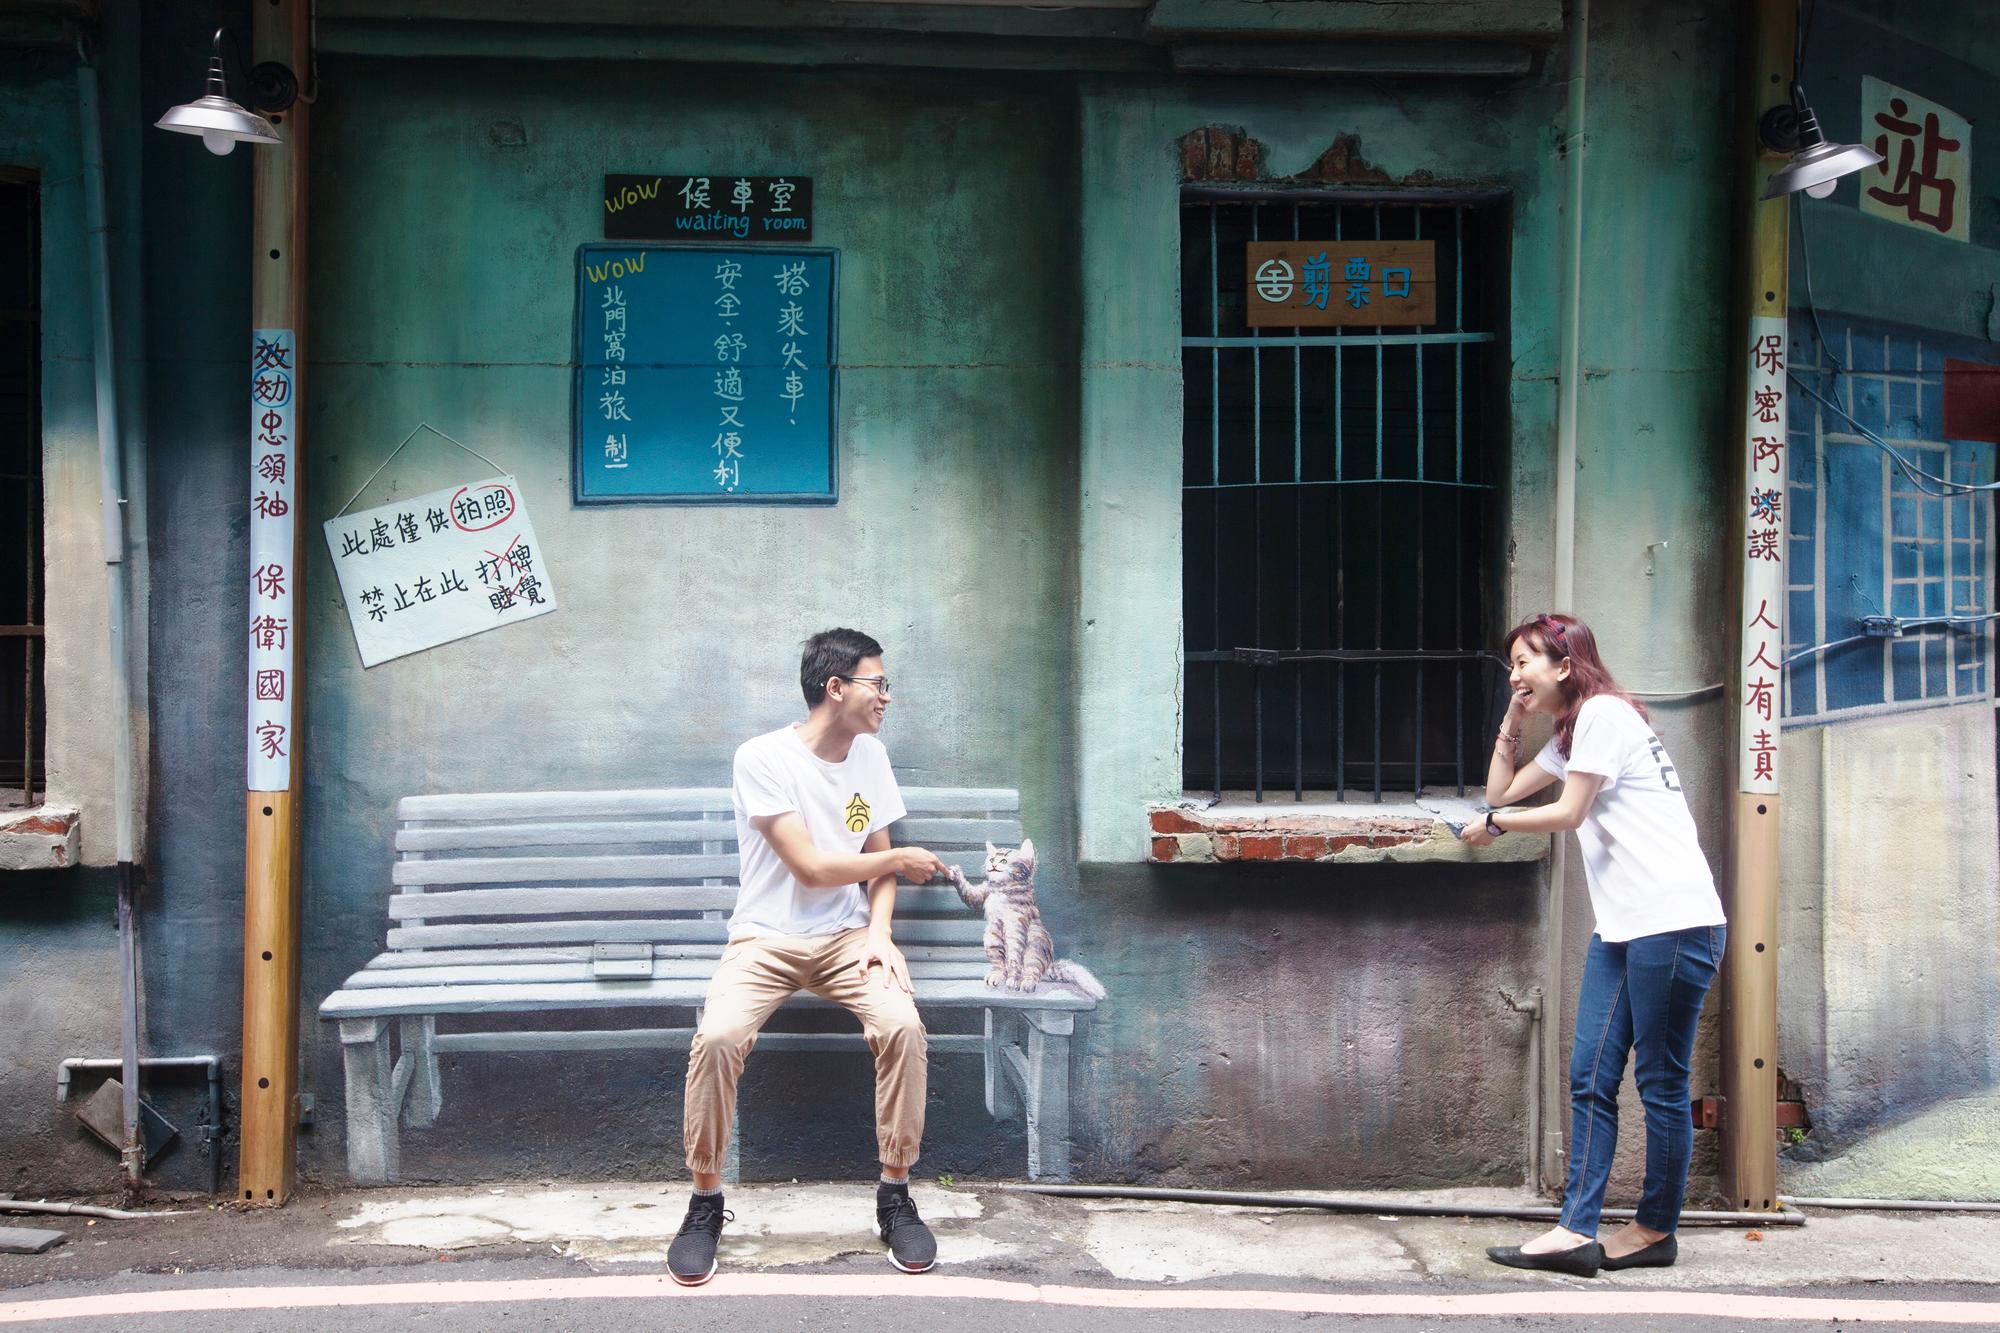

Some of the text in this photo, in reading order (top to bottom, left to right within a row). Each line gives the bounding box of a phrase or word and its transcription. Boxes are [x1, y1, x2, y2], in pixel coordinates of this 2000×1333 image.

[677, 177, 795, 213] 候車室
[1866, 98, 1960, 232] 站
[675, 210, 808, 238] waiting room
[1302, 251, 1412, 311] 剪票口
[360, 544, 534, 623] 禁止在此 打牌
[488, 575, 546, 615] 睡覺
[250, 563, 289, 760] 保衛國家
[1745, 599, 1780, 781] 人人有責
